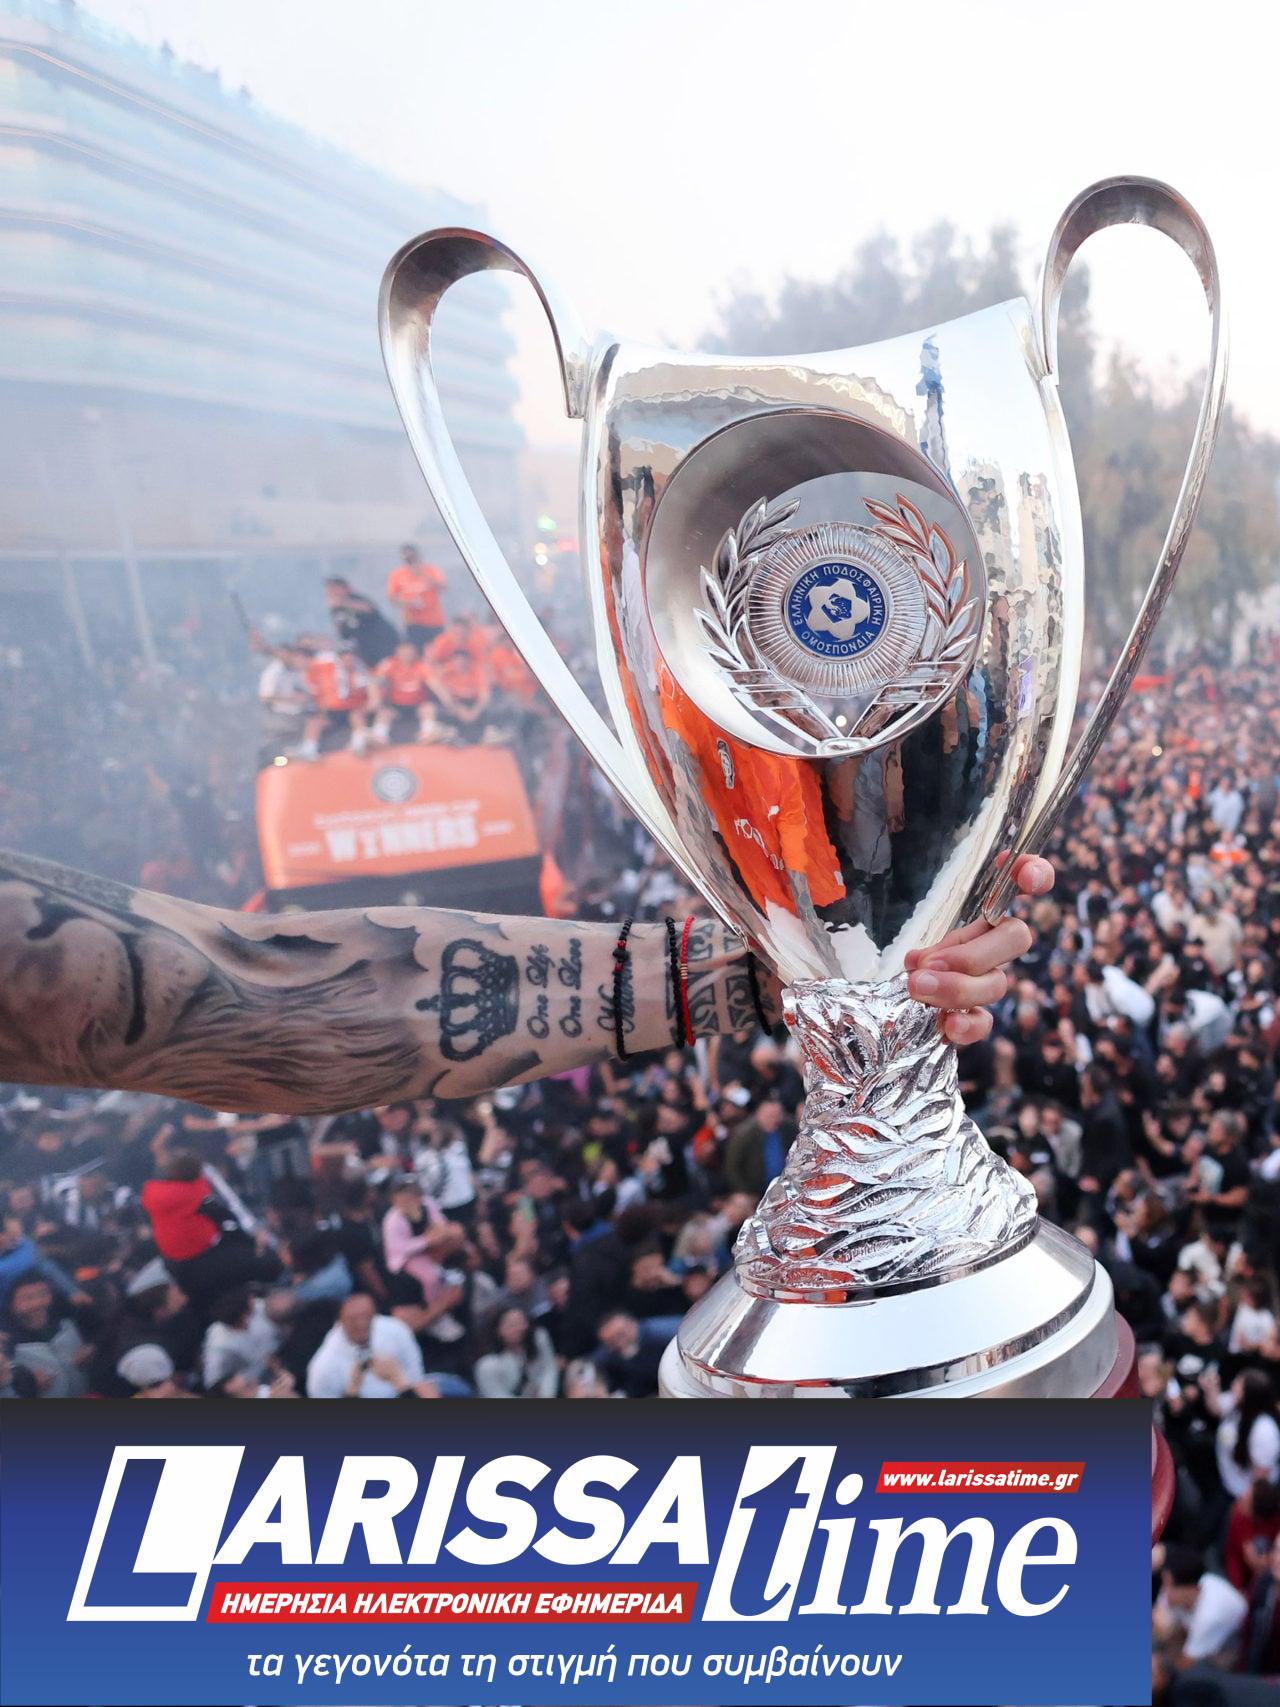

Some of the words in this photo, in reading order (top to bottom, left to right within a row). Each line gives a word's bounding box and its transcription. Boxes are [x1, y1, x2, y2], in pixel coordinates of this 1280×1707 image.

[791, 571, 820, 626] ΕΛΛΗΝΙΚΗ
[822, 565, 882, 626] ΠΟΔΟΣΦΑΙΡΙΚΗ
[801, 630, 876, 655] ΟΜΟΣΠΟΝΔΙΑ
[525, 943, 555, 989] Life
[557, 938, 582, 991] Love
[526, 995, 549, 1039] One
[558, 996, 582, 1038] One
